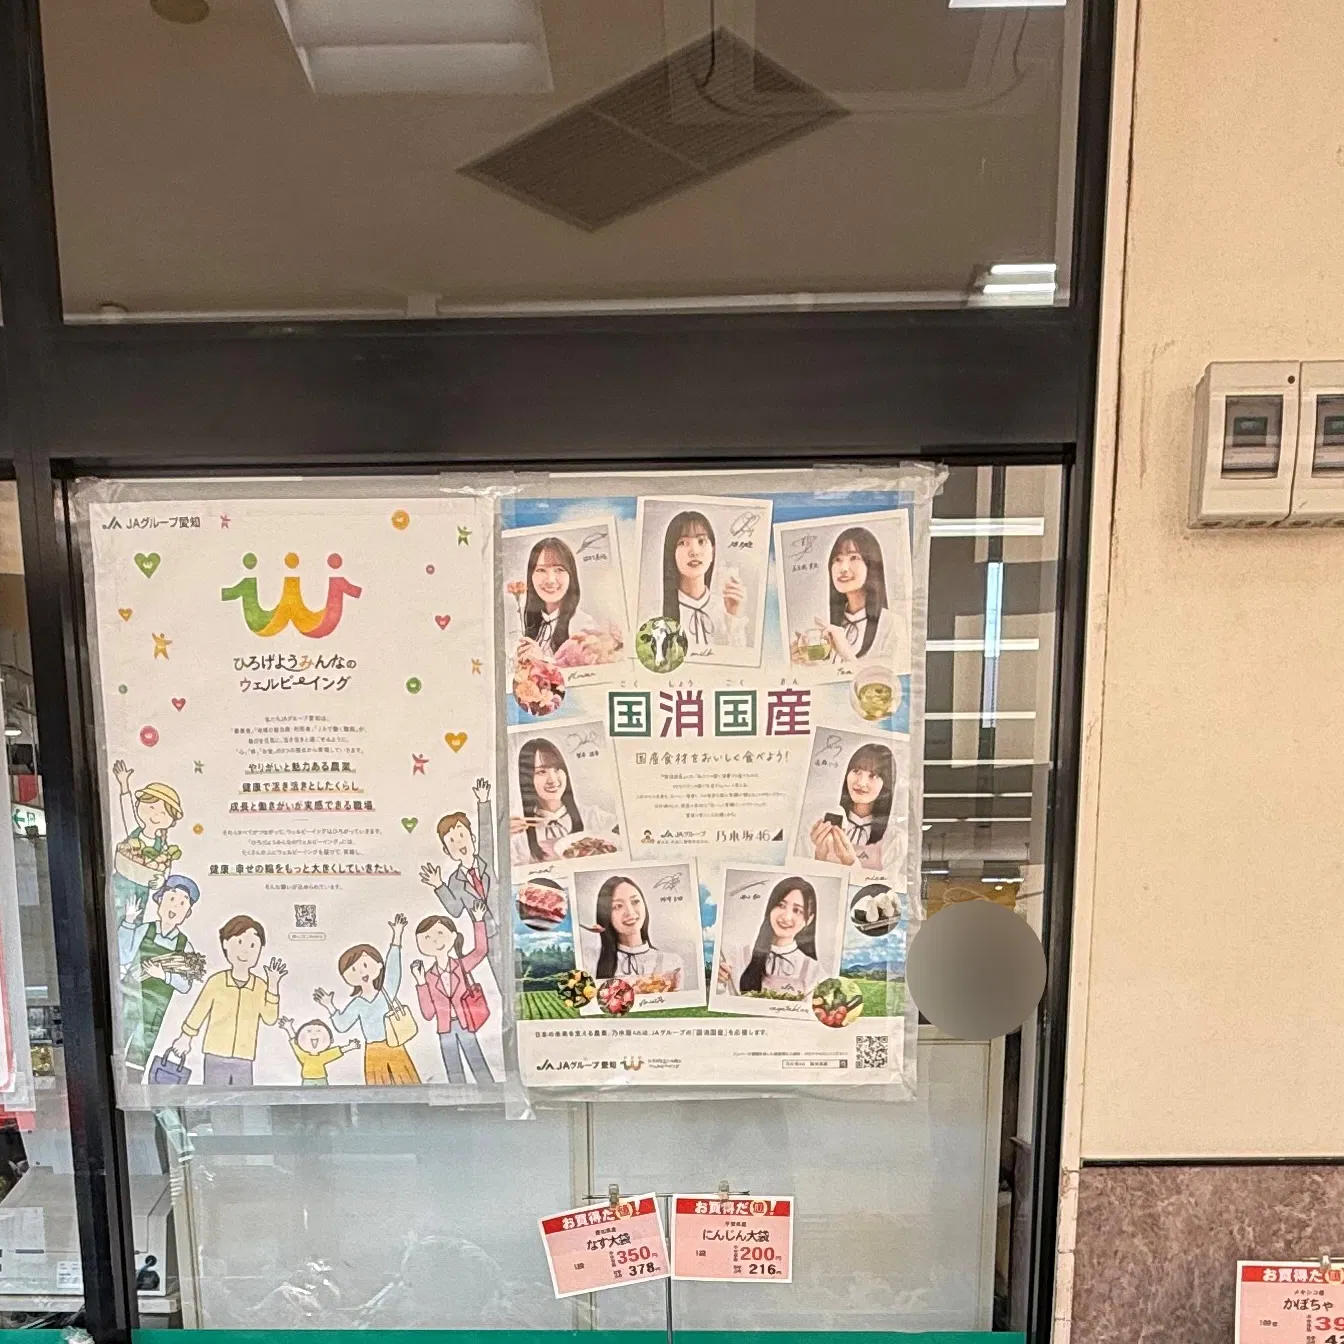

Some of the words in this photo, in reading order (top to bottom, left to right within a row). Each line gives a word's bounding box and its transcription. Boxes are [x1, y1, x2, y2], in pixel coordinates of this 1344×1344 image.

[126, 516, 201, 530] JAグループ愛知
[233, 653, 357, 672] ひろげようみんなの
[239, 674, 352, 692] ウェルビーイング
[608, 688, 812, 738] 国消国産
[557, 1059, 617, 1071] JAグループ愛知
[586, 1232, 632, 1251] なす大袋
[702, 1229, 770, 1243] にんじん大袋
[1282, 1298, 1334, 1312] かぼちゃ
